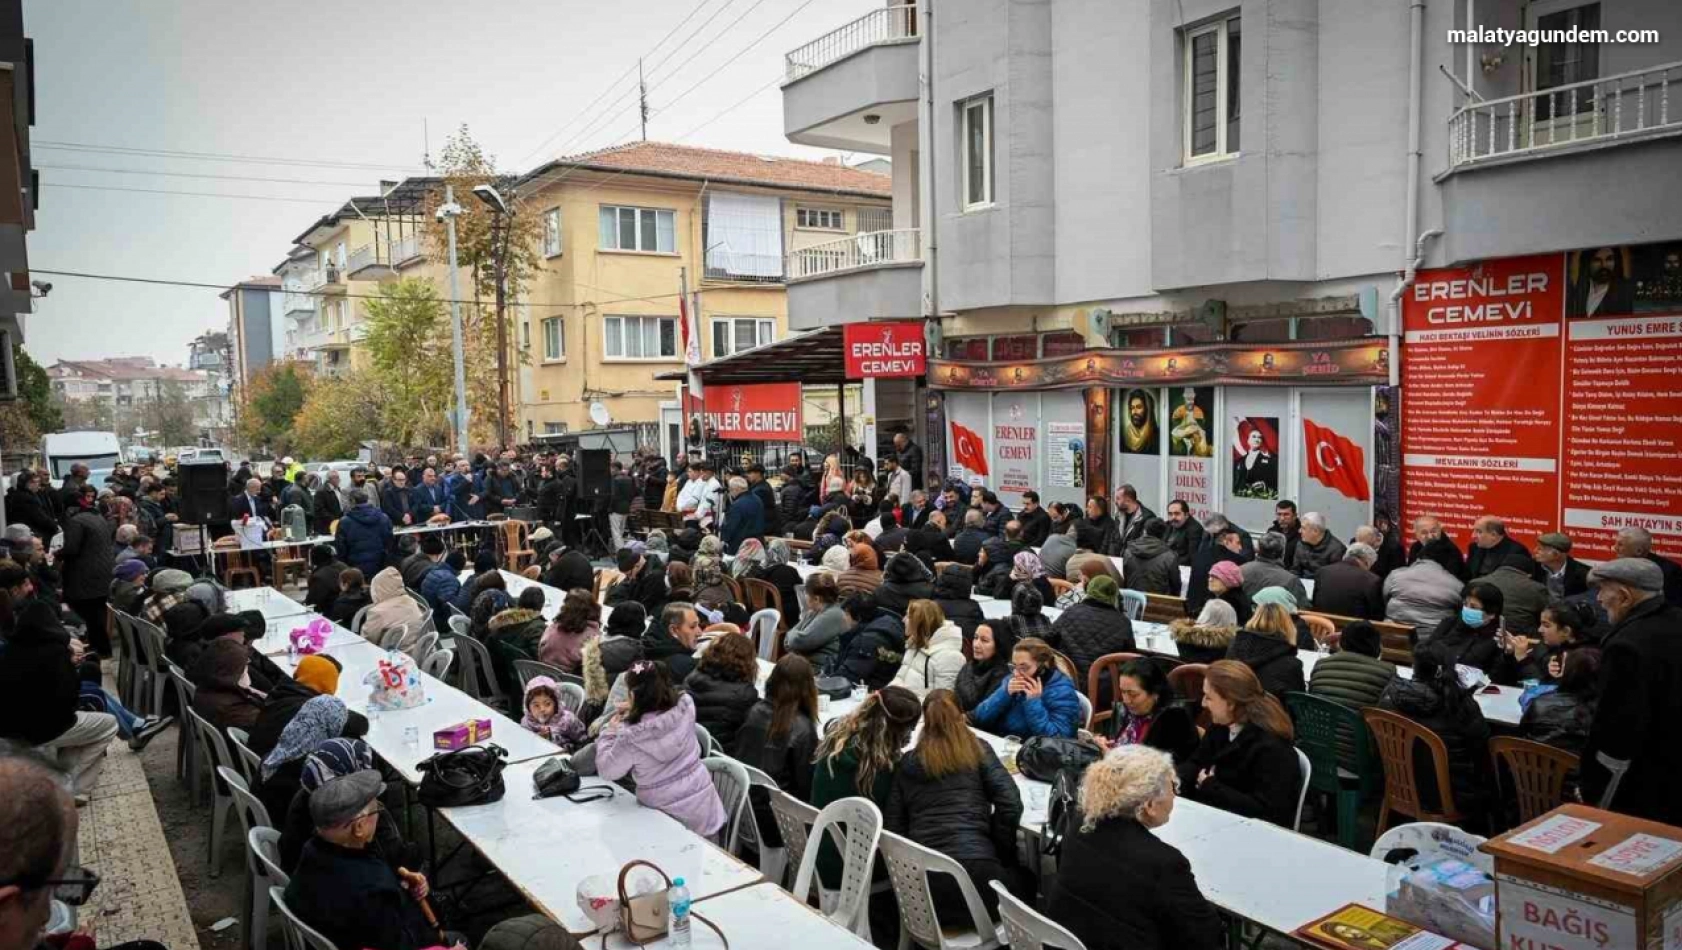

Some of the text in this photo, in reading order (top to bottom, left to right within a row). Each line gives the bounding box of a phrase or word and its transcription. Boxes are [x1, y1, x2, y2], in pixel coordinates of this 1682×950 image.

[1414, 272, 1549, 302] ERENLER
[1505, 327, 1541, 338] SÖZLERİ
[1606, 324, 1643, 336] YUNUS
[1646, 322, 1676, 334] EMRE
[852, 342, 922, 357] ERENLER
[744, 407, 797, 431] CEMEVİ
[994, 425, 1036, 441] ERENLER
[1435, 458, 1519, 468] MEVLANIN SÖZLERİ
[1524, 900, 1610, 948] BAĞIŞ
